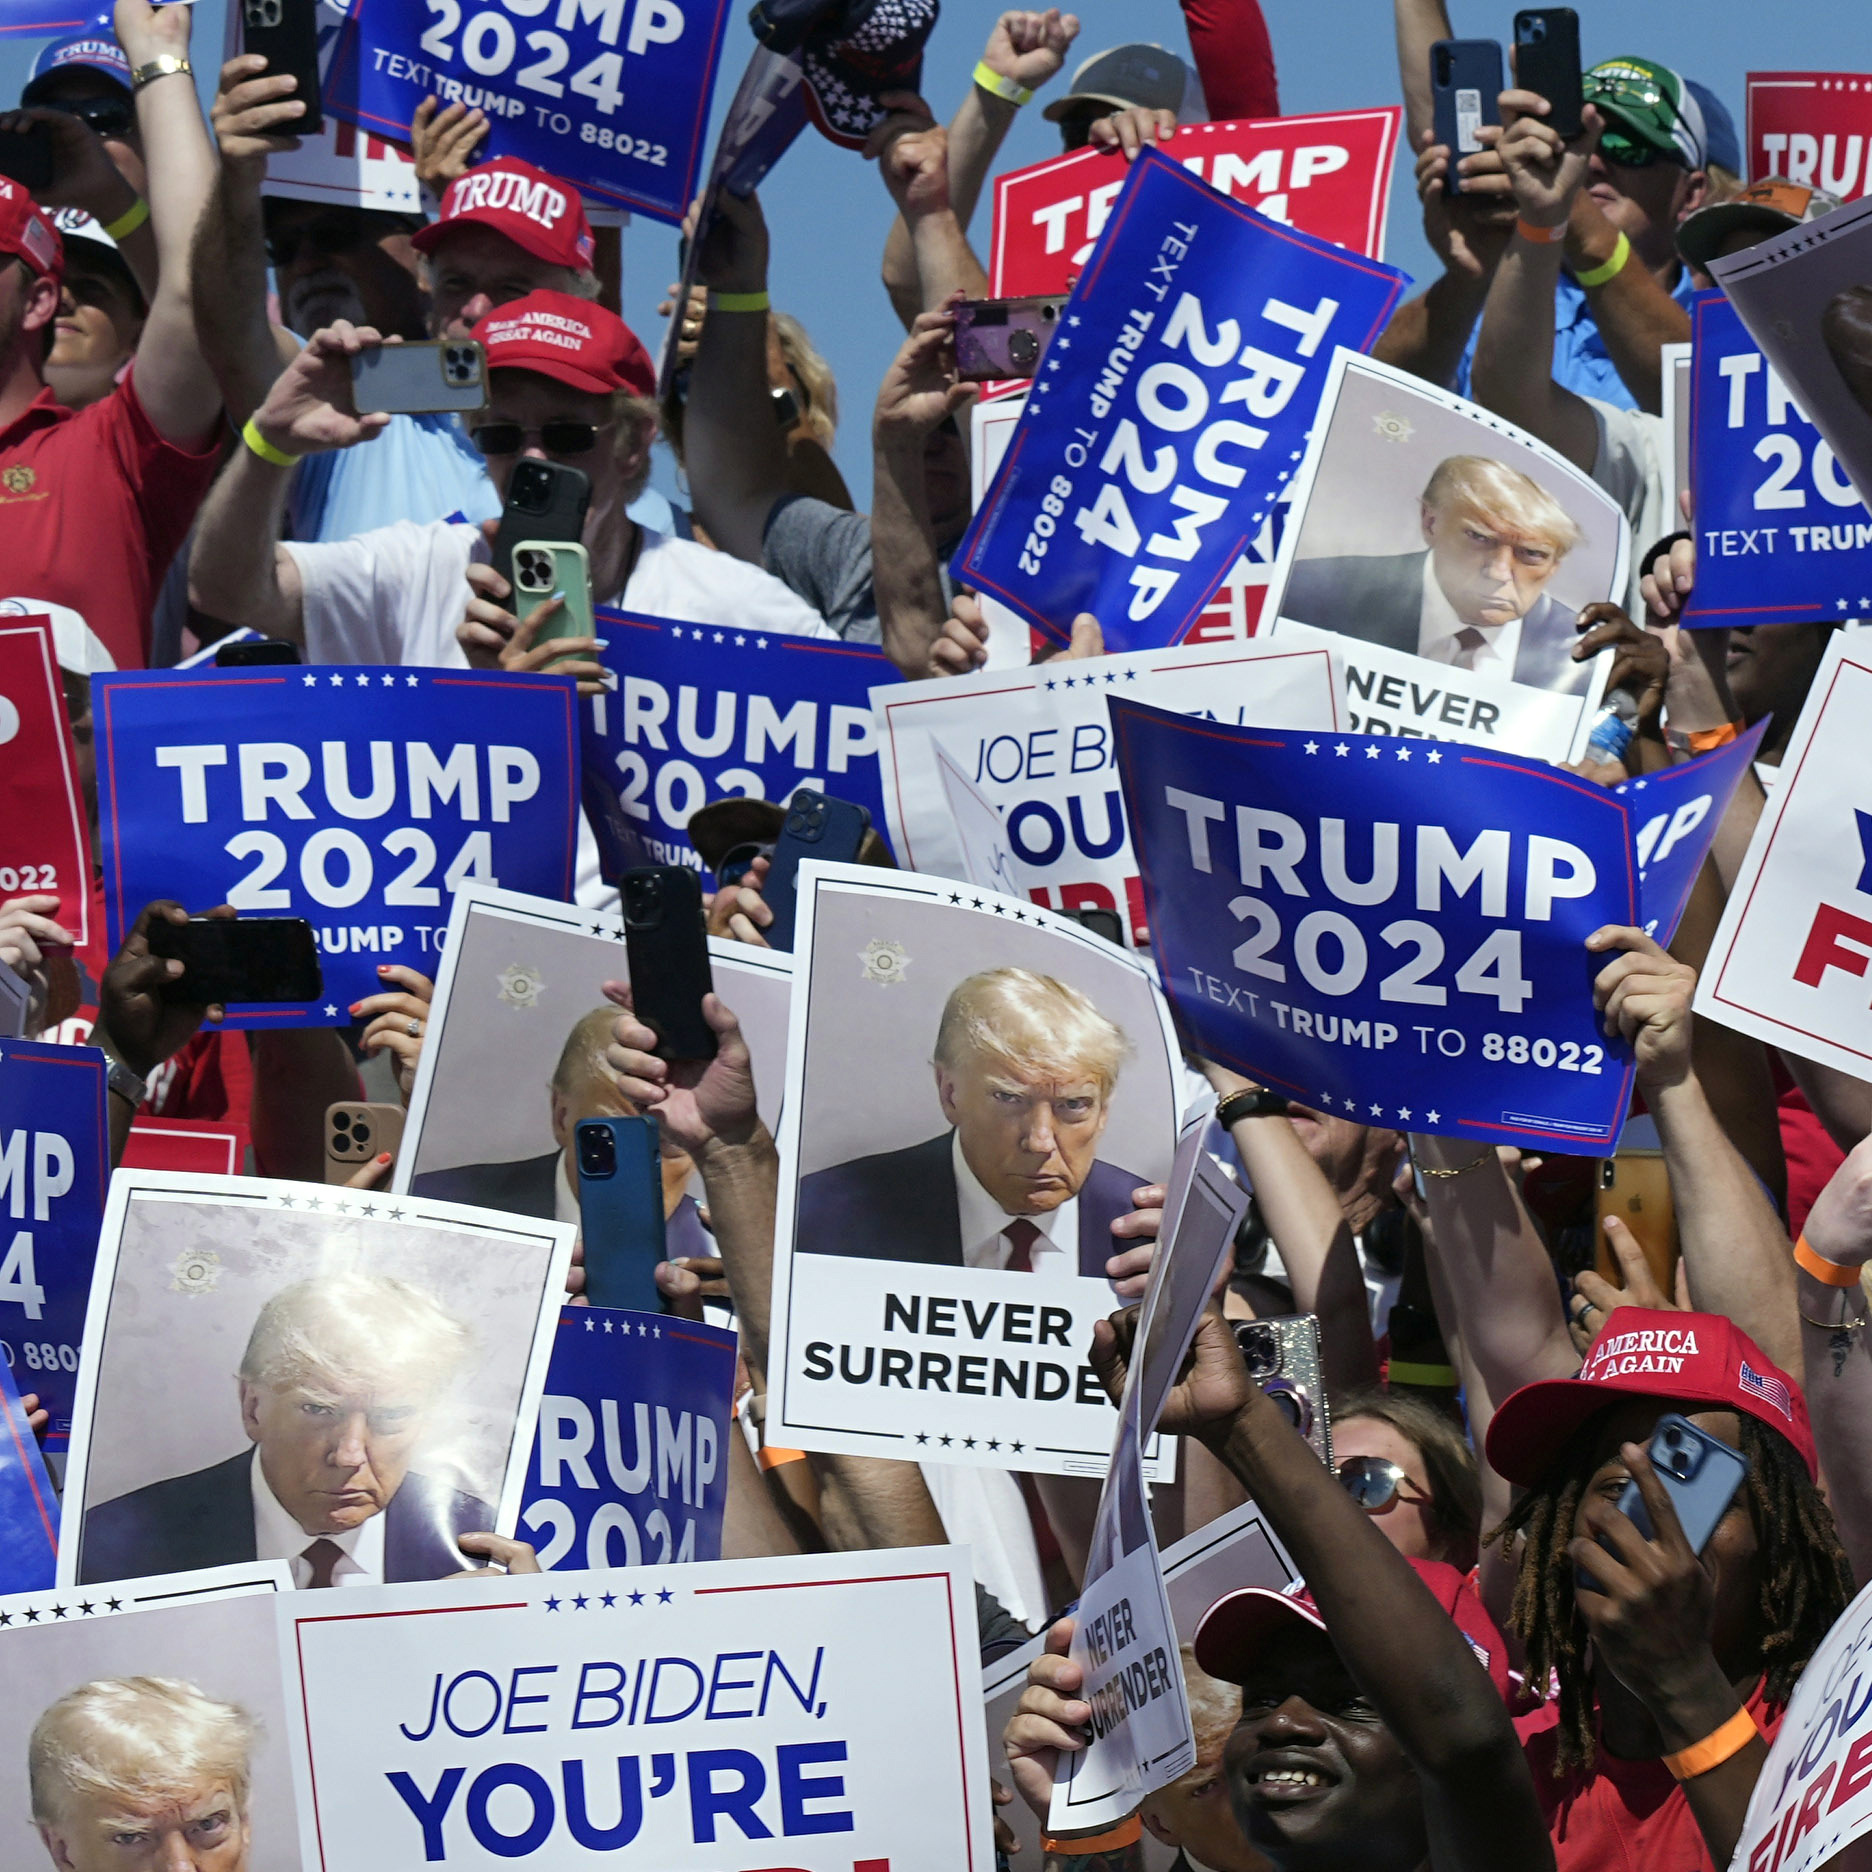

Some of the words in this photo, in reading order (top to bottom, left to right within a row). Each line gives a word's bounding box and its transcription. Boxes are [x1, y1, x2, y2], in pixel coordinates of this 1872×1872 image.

[421, 7, 625, 117] 2024
[373, 47, 432, 88] TEXT
[433, 76, 527, 117] TRUMP
[533, 105, 572, 136] TO
[579, 121, 669, 167] 88022
[450, 171, 568, 231] TRUMP
[1148, 220, 1199, 300] TEXT
[521, 312, 592, 340] AMERICA
[531, 329, 583, 351] AGAIN
[1089, 305, 1155, 430] TRUMP
[1063, 433, 1097, 469] TO
[1074, 292, 1242, 560] 2024
[1131, 297, 1341, 623] TRUMP
[1018, 474, 1074, 577] 88022
[1704, 528, 1779, 556] TEXT
[593, 674, 880, 773] TRUMP
[1342, 664, 1501, 735] NEVER
[155, 739, 542, 826] TRUMP
[974, 734, 1060, 785] JOE
[0, 863, 59, 893] 022
[223, 825, 499, 910] 2024
[1164, 785, 1598, 922] TRUMP
[1227, 895, 1535, 1013] 2024
[1187, 967, 1260, 1018] TEXT
[1269, 1000, 1399, 1051] TRUMP
[1411, 1026, 1467, 1058] TO
[1480, 1033, 1604, 1075] 88022
[883, 1293, 1074, 1347] NEVER
[1594, 1329, 1699, 1368] AMERICA
[802, 1341, 1114, 1406] SURRENDE
[1601, 1355, 1685, 1381] AGAIN
[539, 1395, 719, 1509] RUMP
[1084, 1597, 1138, 1672] NEVER
[399, 1664, 559, 1743] JOE
[572, 1646, 828, 1731] BIDEN,
[384, 1741, 856, 1863] YOU'RE
